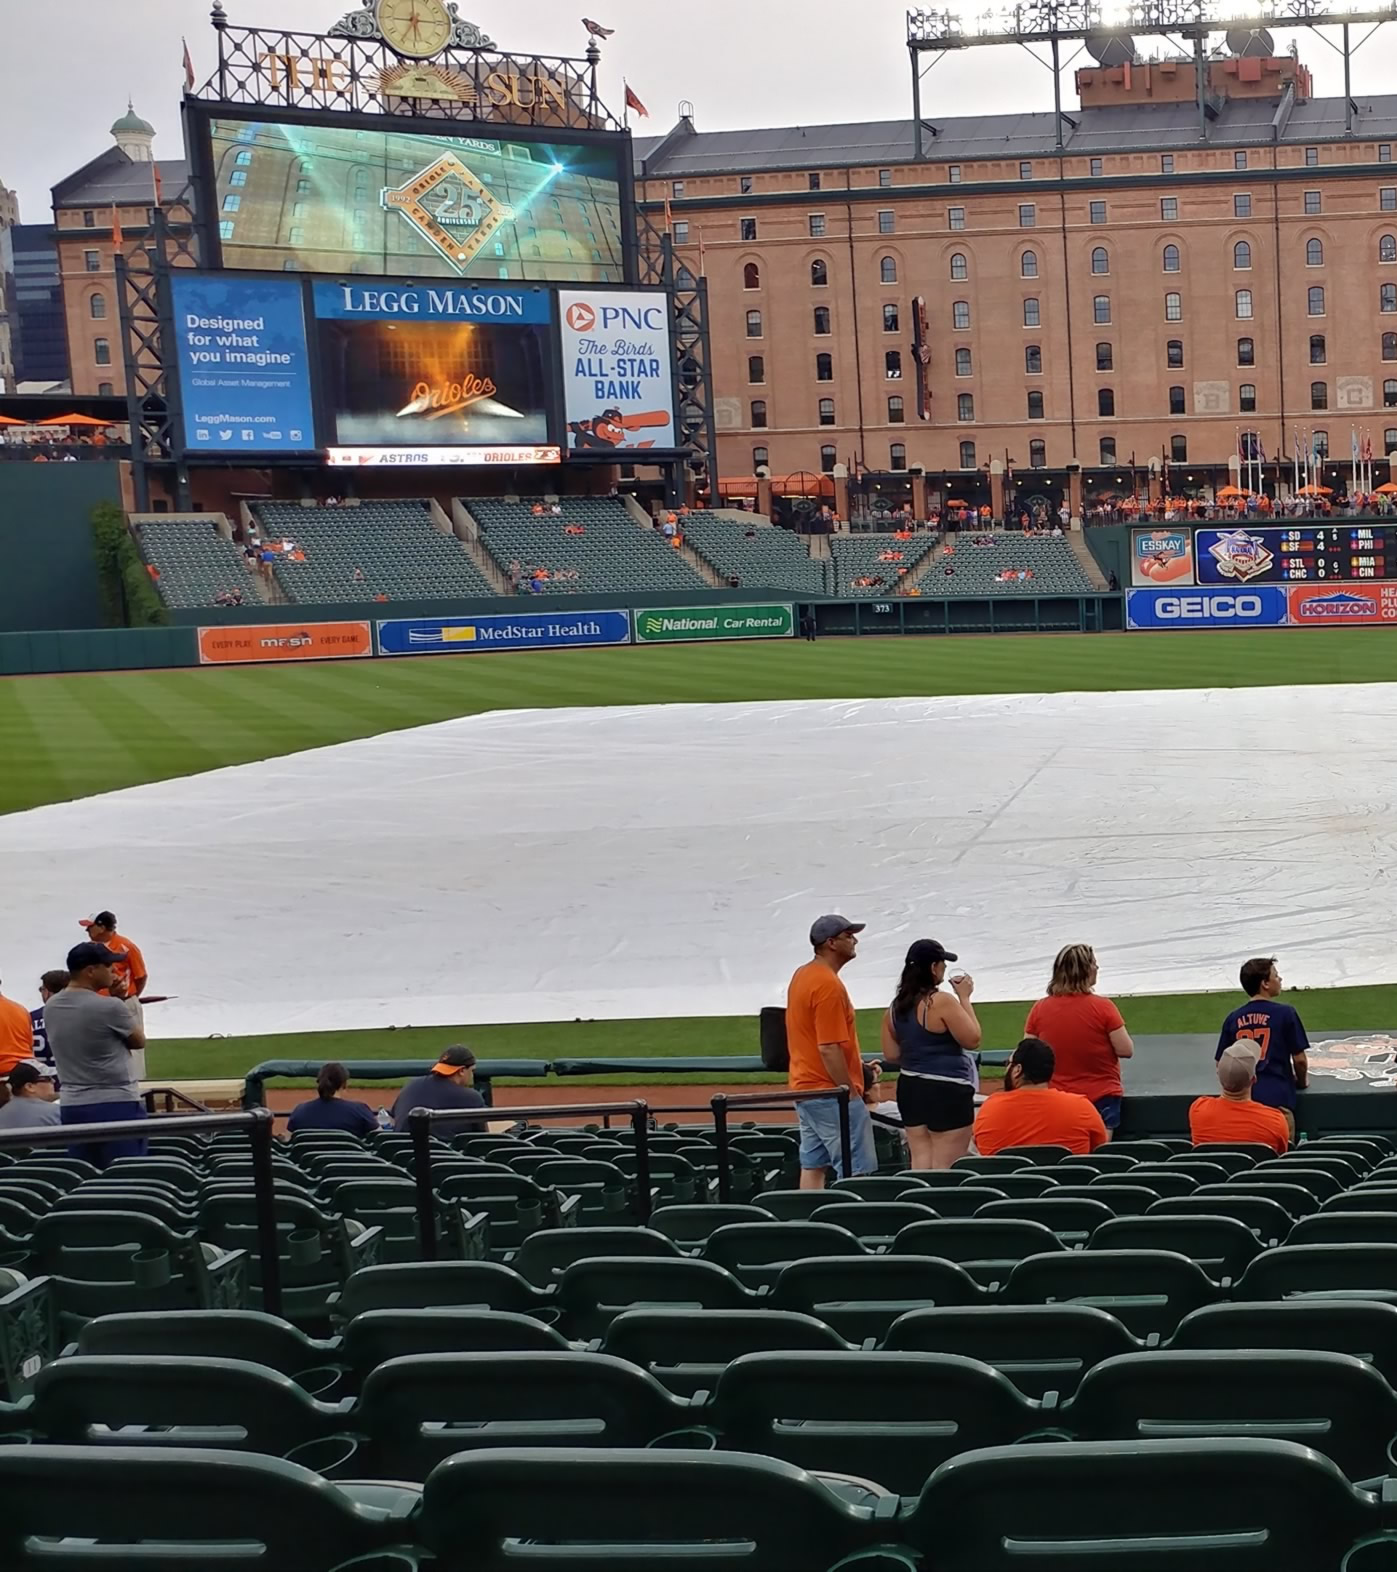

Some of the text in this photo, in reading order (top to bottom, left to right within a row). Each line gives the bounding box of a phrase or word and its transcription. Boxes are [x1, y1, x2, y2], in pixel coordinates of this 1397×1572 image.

[260, 51, 567, 109] THE SUN
[343, 286, 524, 316] LEGG MASON
[187, 315, 265, 332] Designed
[599, 306, 664, 330] PNC
[188, 332, 260, 347] for what
[578, 338, 656, 357] The Birds
[190, 351, 221, 365] you
[575, 358, 661, 379] ALL-STAR
[192, 378, 291, 389] Global Asset Management
[410, 372, 498, 414] Orioles
[594, 380, 643, 400] BANK
[195, 414, 276, 425] LeggMason.com
[378, 453, 429, 463] ASTROS
[483, 452, 533, 463] ORIOLES
[1288, 531, 1325, 540] SD 4
[1357, 529, 1373, 539] MIL
[1142, 539, 1181, 551] ESSKAY
[1288, 541, 1325, 551] SF 4
[1358, 540, 1374, 550] PHI
[1289, 558, 1325, 569] STL 0
[1358, 557, 1376, 567] MIA
[1289, 569, 1326, 579] CHC 0
[1359, 567, 1375, 577] CIN
[875, 604, 890, 613] 373
[1155, 595, 1262, 619] GEICO
[1302, 602, 1375, 615] HORIZON
[662, 616, 783, 630] National Car Rental
[479, 620, 601, 641] MedStar Health
[260, 636, 313, 648] masn
[320, 636, 341, 645] EVERY
[1237, 1012, 1271, 1029] ALTUVE
